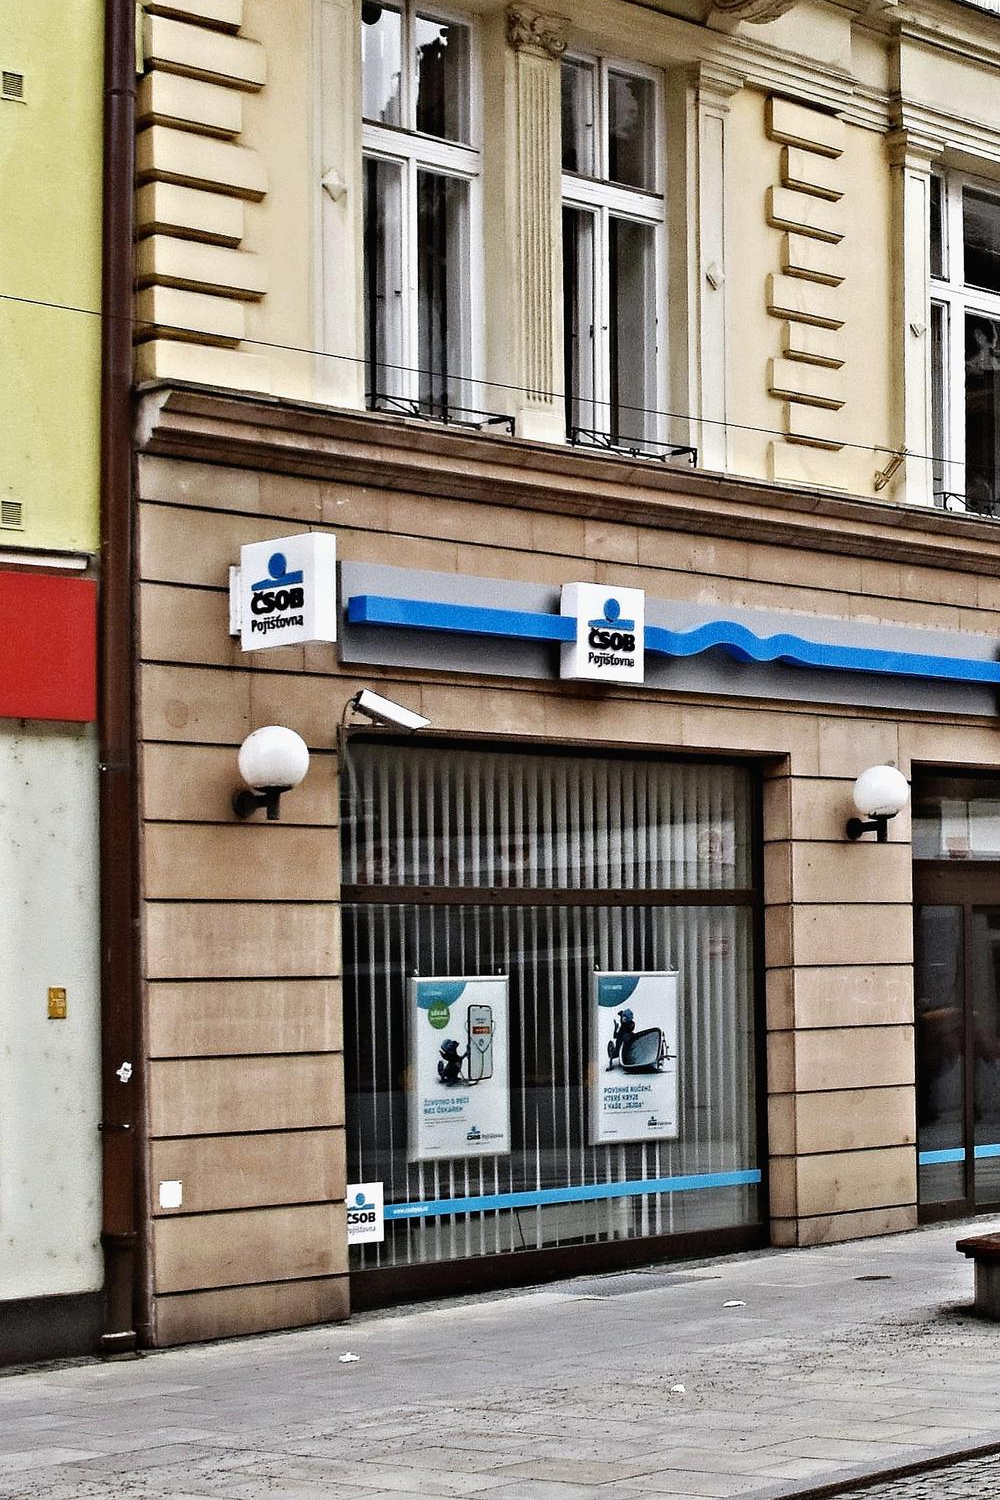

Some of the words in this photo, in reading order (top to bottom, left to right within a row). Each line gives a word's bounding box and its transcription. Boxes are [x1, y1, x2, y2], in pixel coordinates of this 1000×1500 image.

[251, 588, 304, 615] ČSOB
[251, 615, 304, 635] Pojišťovna
[588, 627, 635, 652] ČSOB
[588, 652, 635, 668] Pojišťovna
